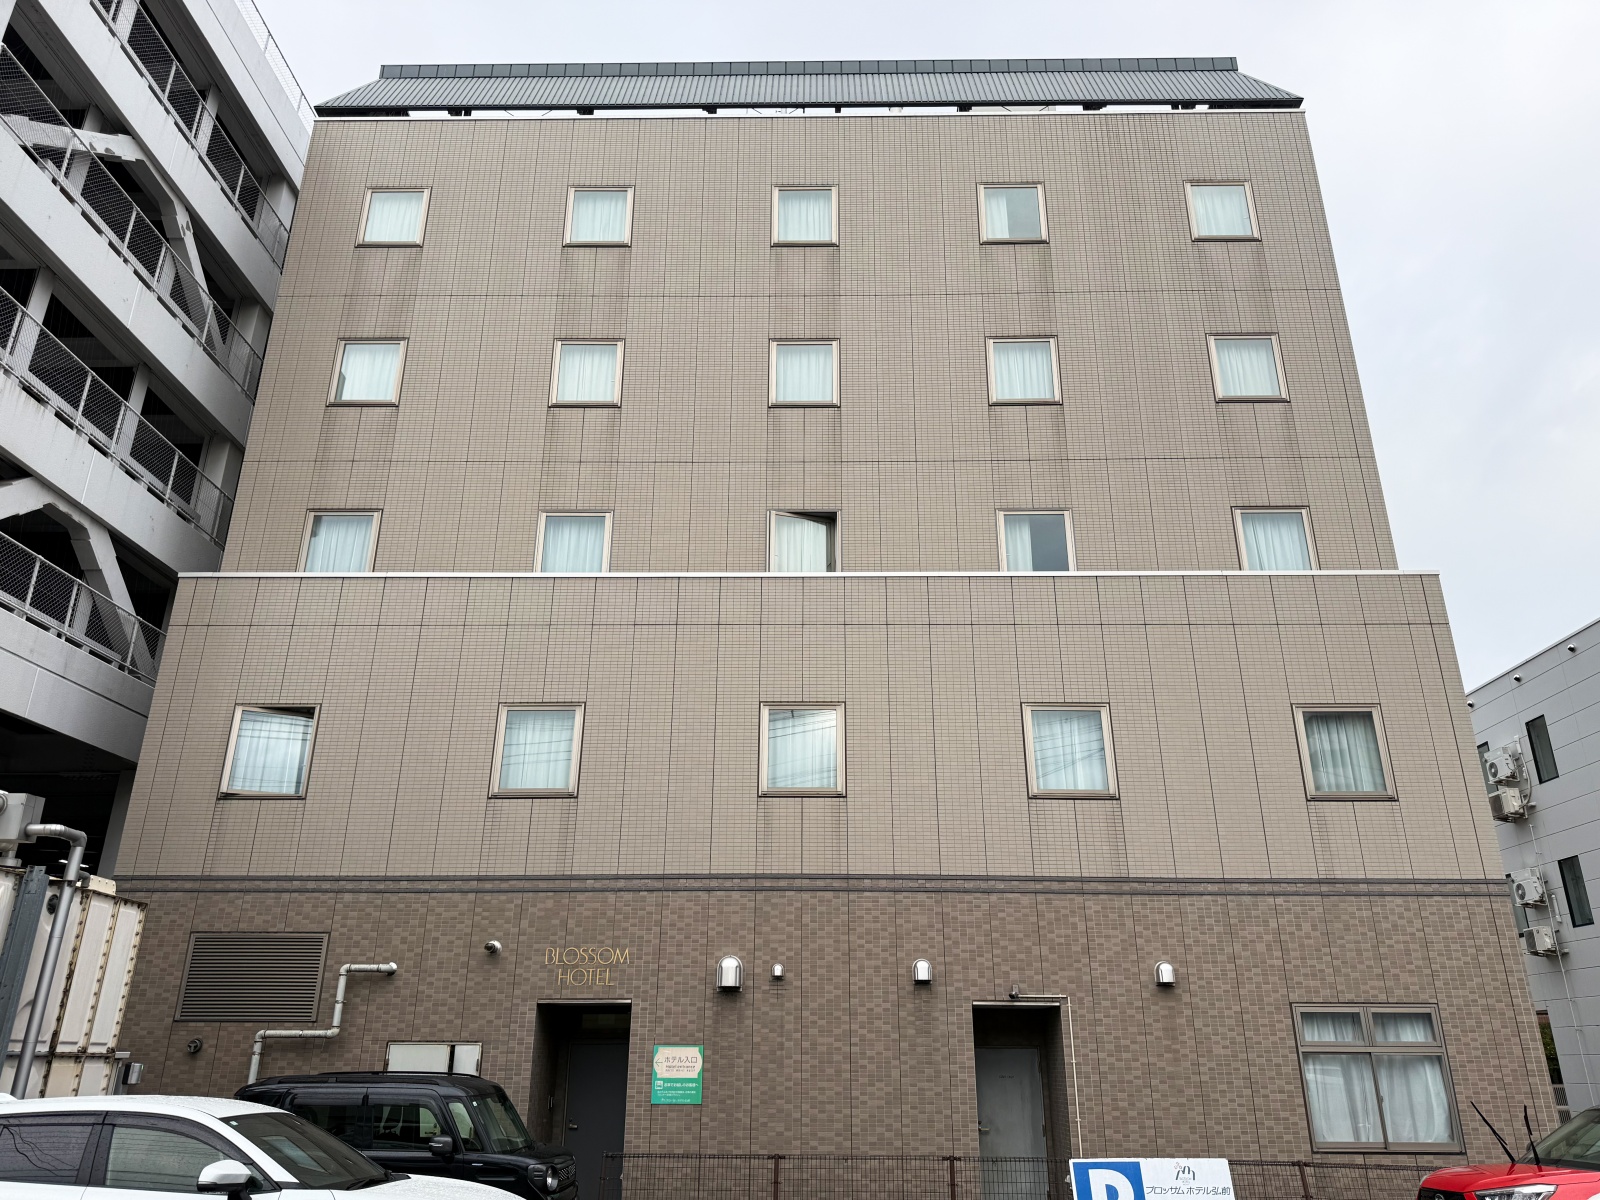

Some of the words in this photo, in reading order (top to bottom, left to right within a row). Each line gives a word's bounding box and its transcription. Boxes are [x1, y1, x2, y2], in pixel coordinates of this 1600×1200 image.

[545, 947, 630, 965] BLOSSOM
[558, 968, 615, 986] HOTEL
[1186, 1186, 1231, 1196] ホテル弘前
